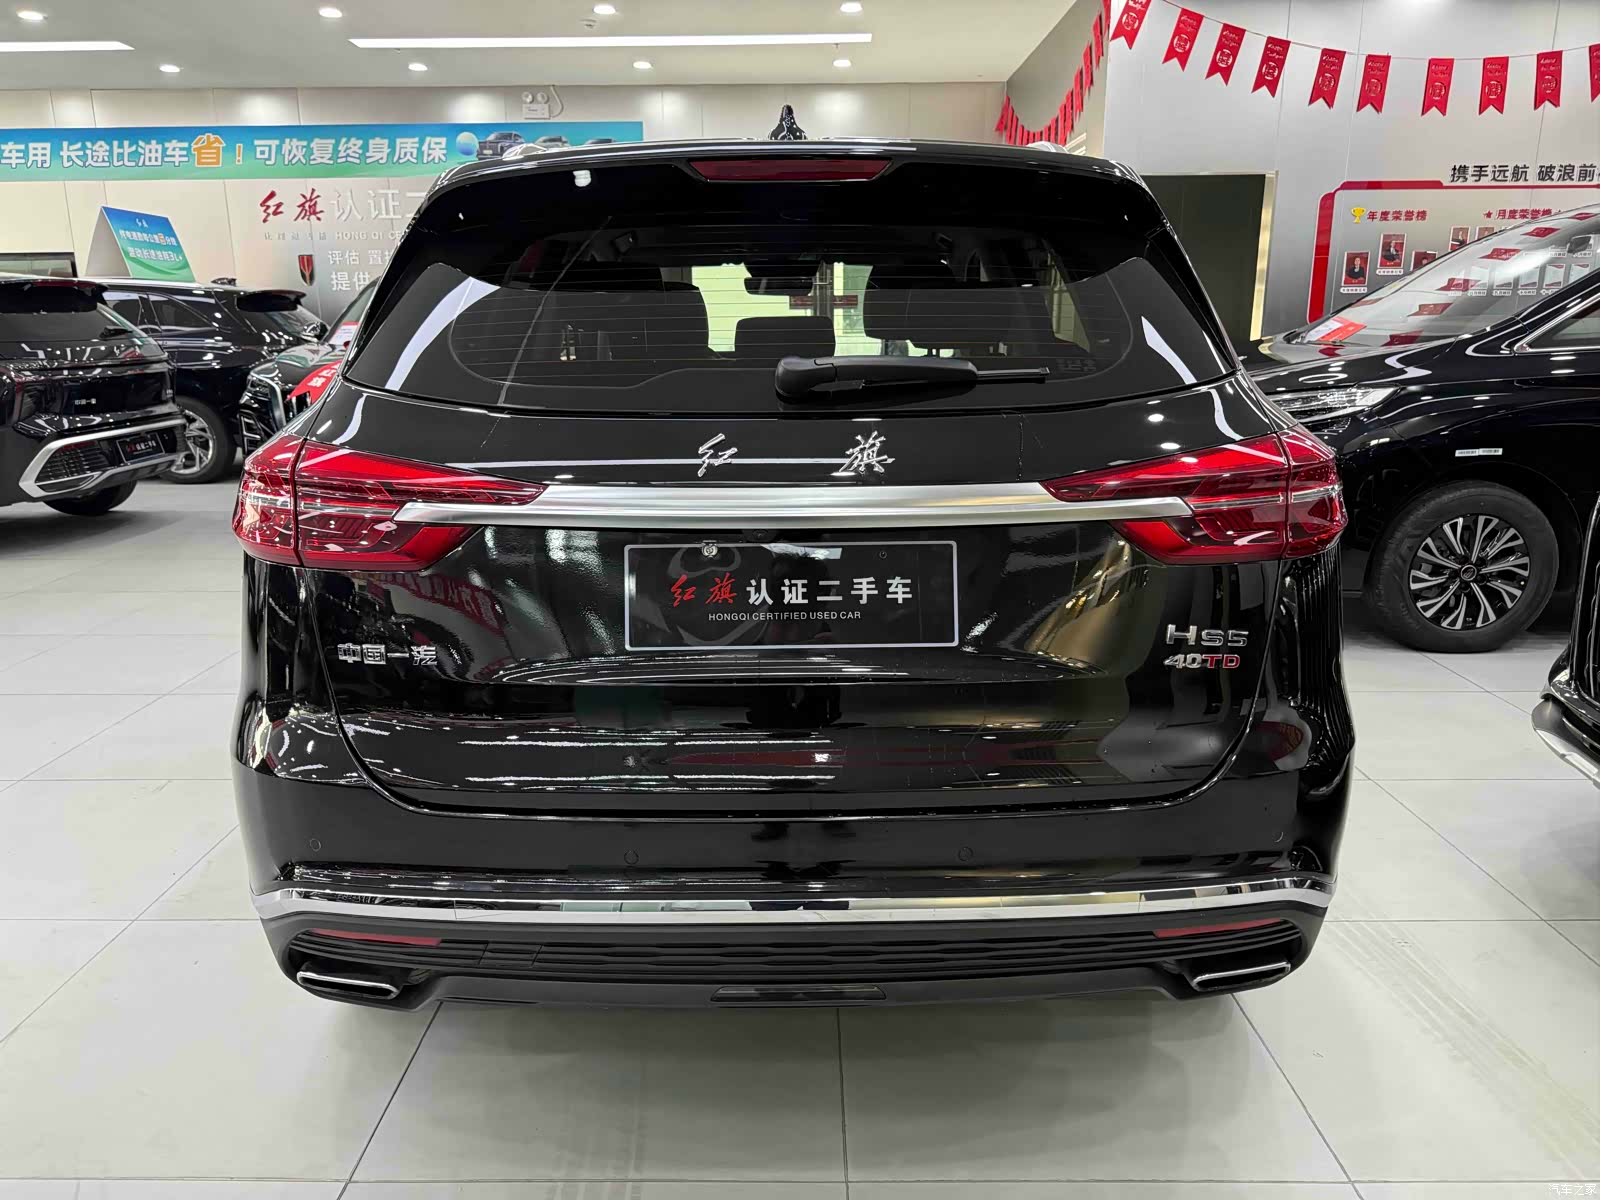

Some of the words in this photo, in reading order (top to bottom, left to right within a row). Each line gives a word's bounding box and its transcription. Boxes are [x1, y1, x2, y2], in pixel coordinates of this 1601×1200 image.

[0, 141, 51, 168] 车用
[1450, 164, 1530, 183] 携手远航
[1537, 163, 1600, 182] 破浪前
[1367, 209, 1428, 222] 年度荣誉榜
[335, 231, 367, 241] HONG
[328, 250, 360, 265] 评估
[331, 271, 371, 291] 提供
[670, 572, 913, 607] 红旗认证二手车
[708, 612, 750, 621] HONGQI
[752, 612, 807, 621] CERTIFIED
[809, 611, 838, 620] USED
[839, 611, 861, 620] CAR
[1166, 624, 1249, 646] HS5
[337, 643, 438, 665] 中国一汽
[1163, 653, 1241, 668] 40TD
